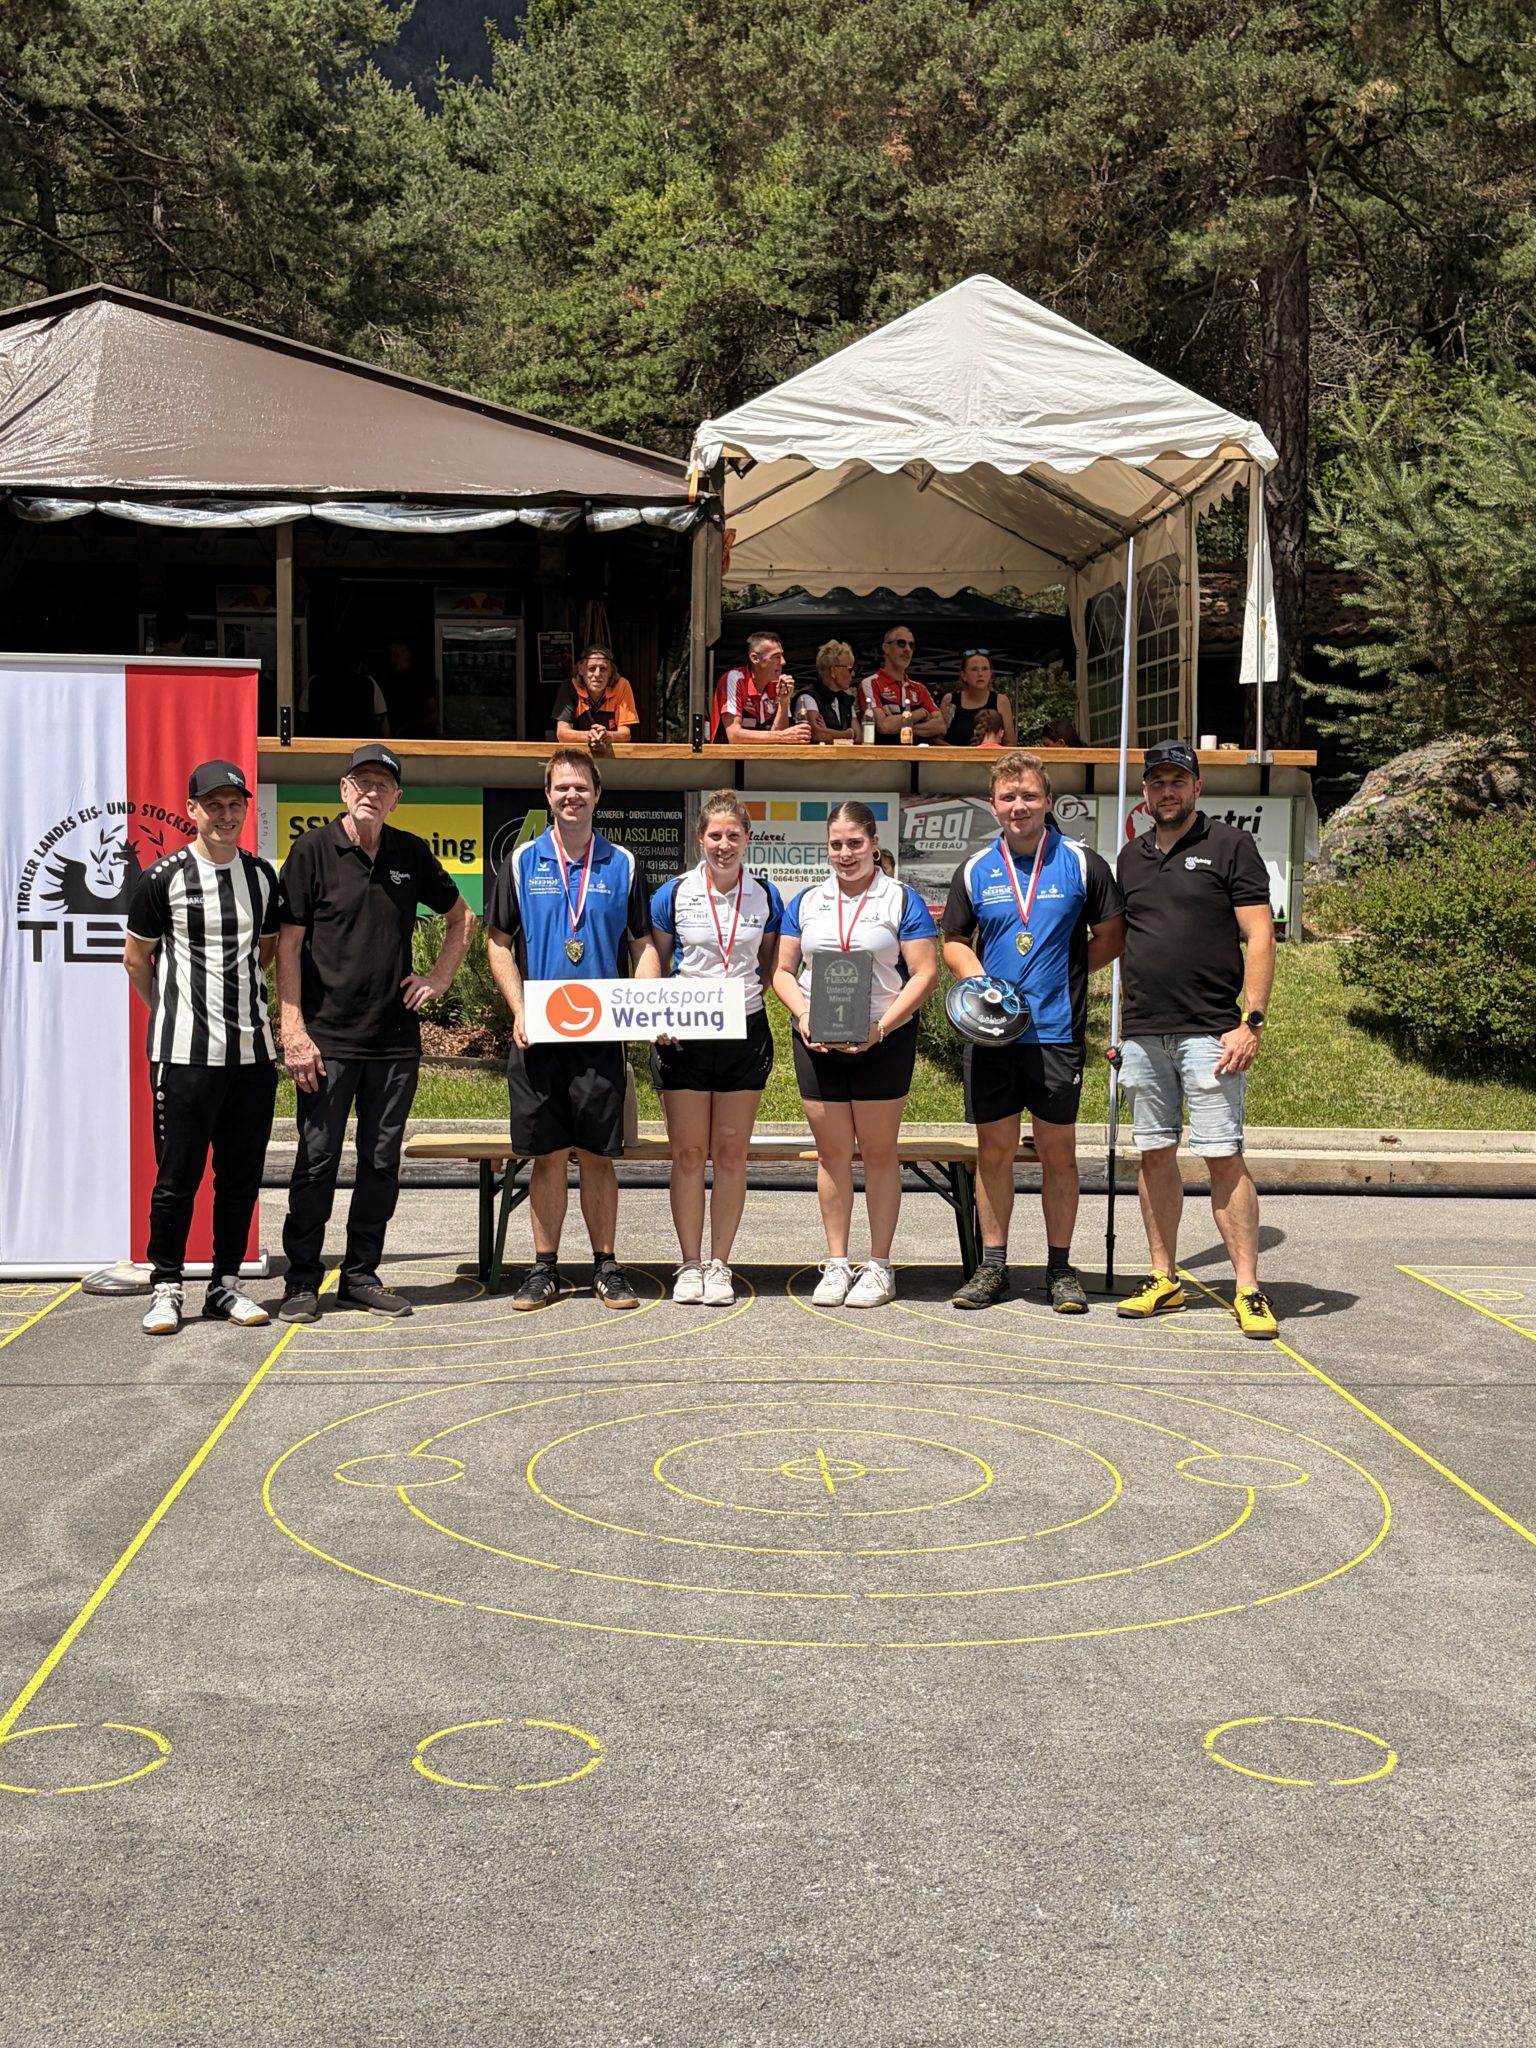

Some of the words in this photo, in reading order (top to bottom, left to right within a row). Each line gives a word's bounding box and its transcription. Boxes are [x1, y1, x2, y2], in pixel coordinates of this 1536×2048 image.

[596, 810, 624, 819] SANIEREN
[629, 810, 683, 820] DIENSTLEISTUNGEN
[1211, 805, 1263, 834] tri
[624, 827, 679, 843] ASSLABER
[424, 831, 477, 864] ing
[651, 846, 679, 856] HAIMING
[919, 841, 963, 850] TIEFBAU
[16, 858, 41, 914] TIROLER
[36, 815, 77, 858] LANDES
[78, 804, 103, 824] EIS-
[106, 801, 136, 816] UND
[610, 987, 724, 1007] Stocksport
[612, 1006, 725, 1031] Wertung
[835, 1004, 844, 1022] 1
